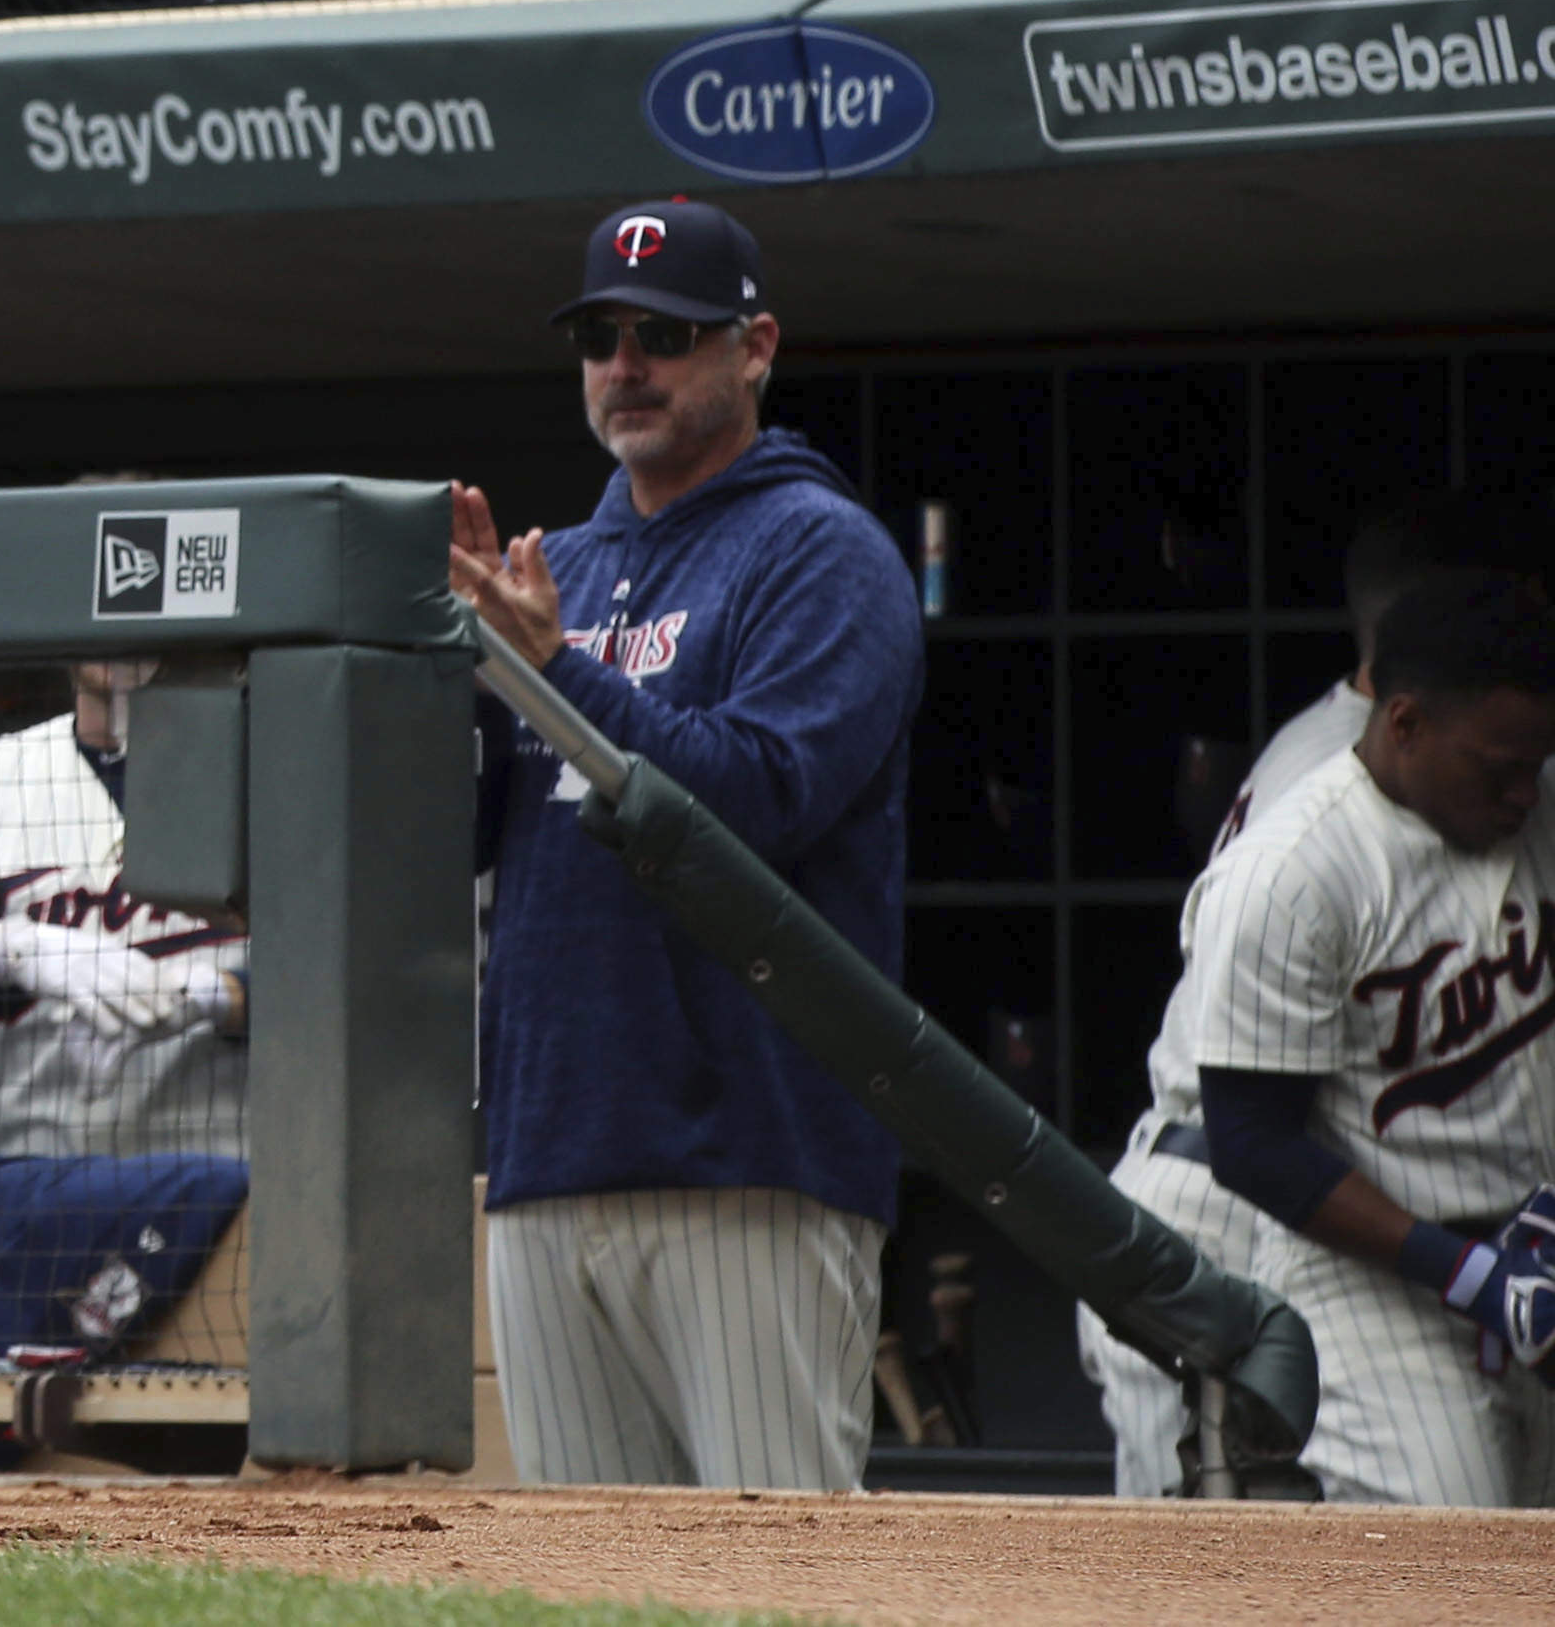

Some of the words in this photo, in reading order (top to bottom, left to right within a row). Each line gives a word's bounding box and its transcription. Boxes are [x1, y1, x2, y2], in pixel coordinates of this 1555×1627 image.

[684, 64, 895, 138] Carrier
[21, 87, 495, 185] StayComfy.com
[177, 534, 228, 563] NEW
[175, 565, 226, 593] ERA
